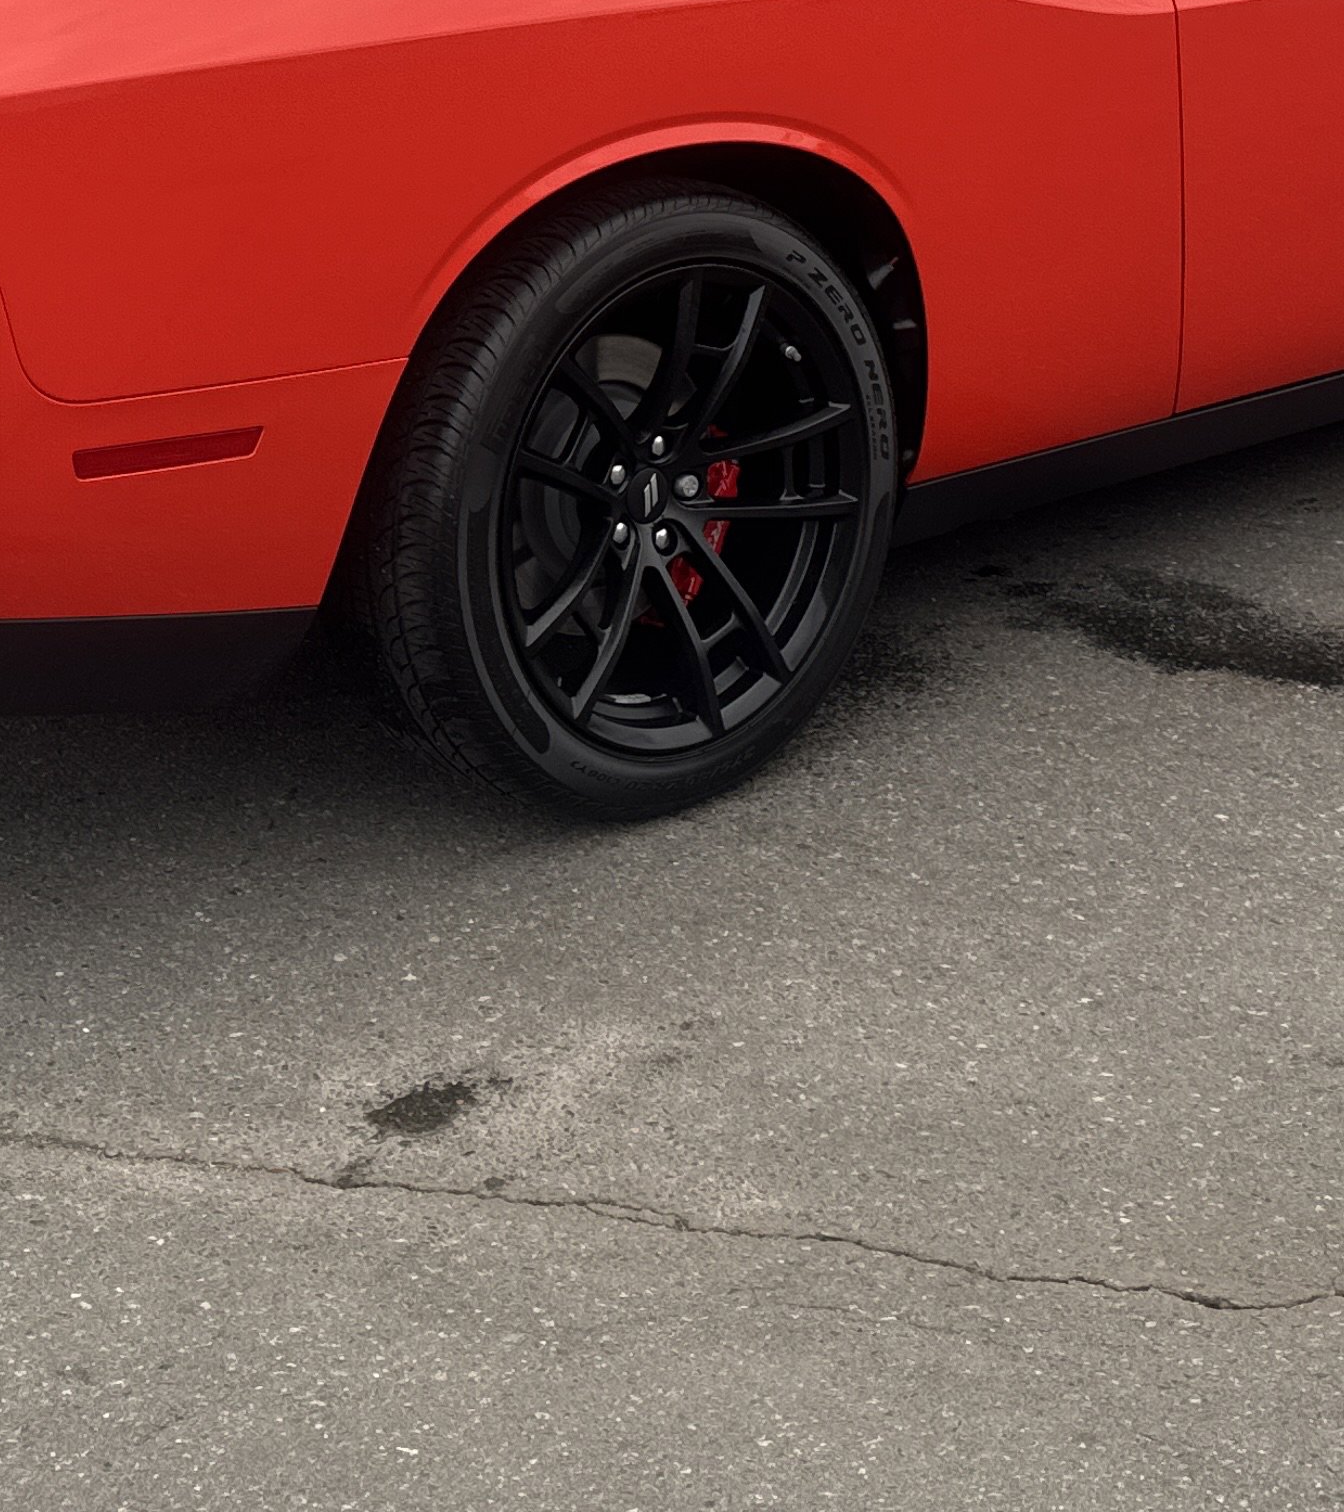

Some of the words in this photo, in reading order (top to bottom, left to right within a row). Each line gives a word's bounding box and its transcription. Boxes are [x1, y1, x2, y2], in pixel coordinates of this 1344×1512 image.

[785, 249, 807, 265] P
[808, 267, 867, 347] ZERO
[863, 359, 890, 461] NERO
